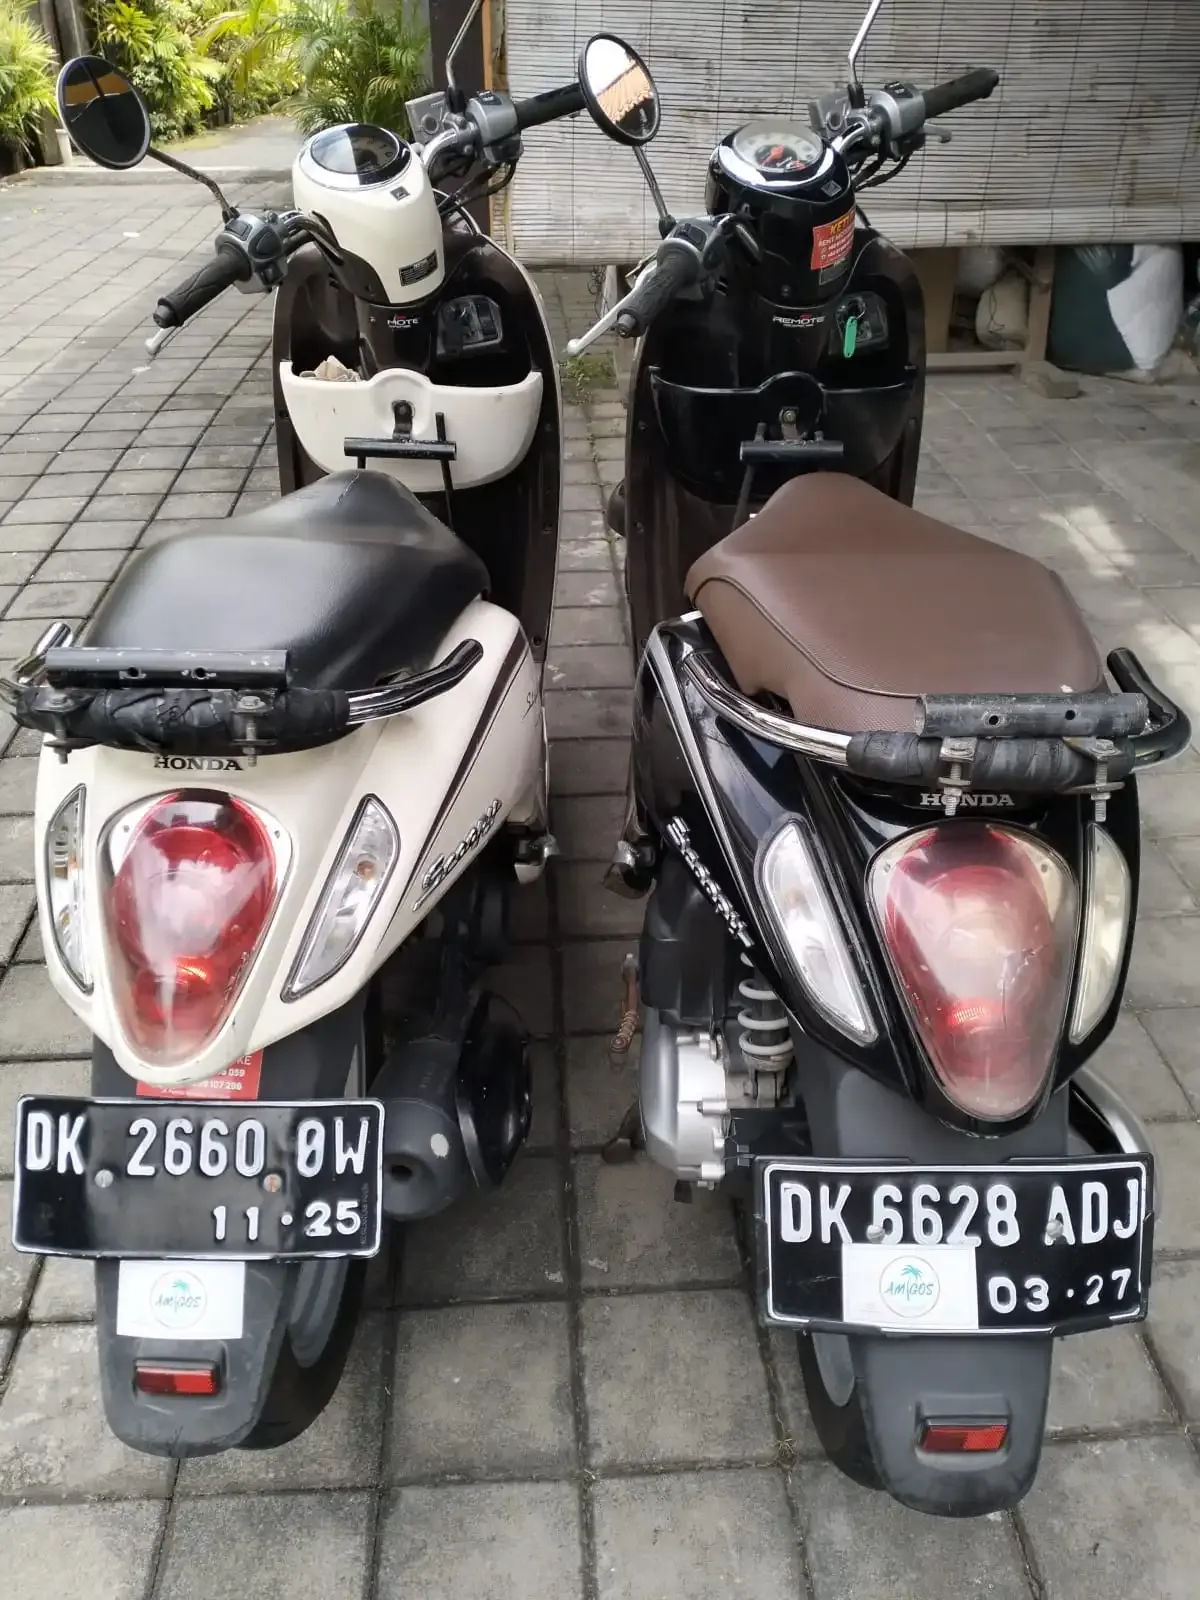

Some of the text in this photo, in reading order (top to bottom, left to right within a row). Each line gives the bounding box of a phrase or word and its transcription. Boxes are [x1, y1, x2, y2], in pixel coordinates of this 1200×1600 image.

[153, 755, 244, 771] HONDA
[25, 1111, 87, 1176] DK
[127, 1118, 267, 1177] 2660
[779, 1178, 1141, 1248] DK 6628 ADJ
[884, 1280, 934, 1301] AMIGOS
